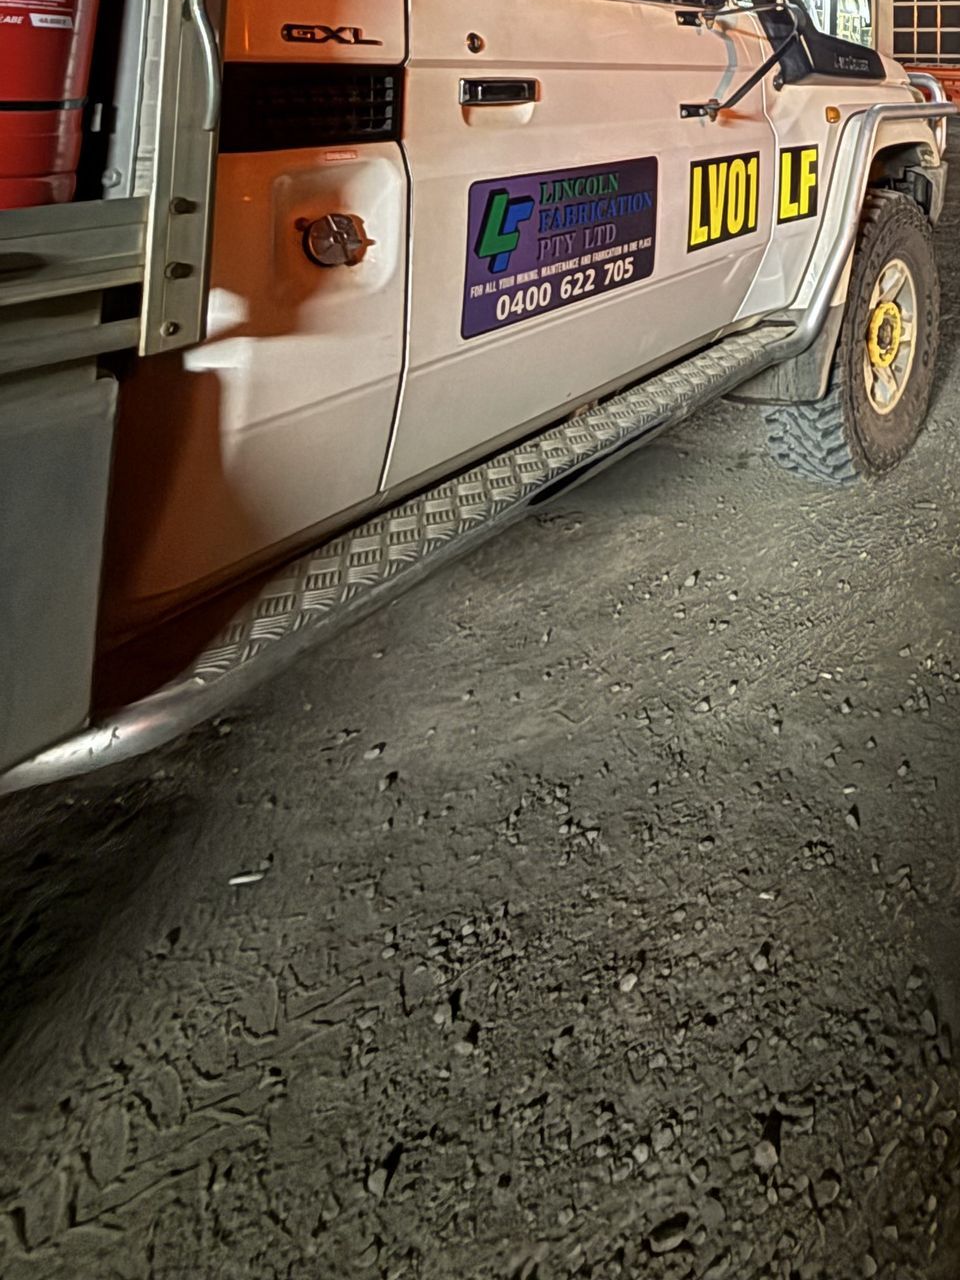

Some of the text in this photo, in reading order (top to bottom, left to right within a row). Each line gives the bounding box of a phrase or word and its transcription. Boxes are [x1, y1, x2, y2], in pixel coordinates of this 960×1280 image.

[281, 23, 383, 46] GXL
[539, 173, 620, 205] LINCOLN
[779, 148, 817, 220] LF
[538, 191, 653, 233] FABRICATION
[537, 223, 617, 261] PTY LTD
[470, 285, 483, 299] FOR
[485, 282, 497, 293] ALL
[499, 275, 515, 289] YOUR
[541, 257, 579, 277] MAINTENANCE
[580, 254, 592, 266] AND
[592, 245, 623, 262] FABRICATION
[495, 257, 635, 321] 0400 622 705
